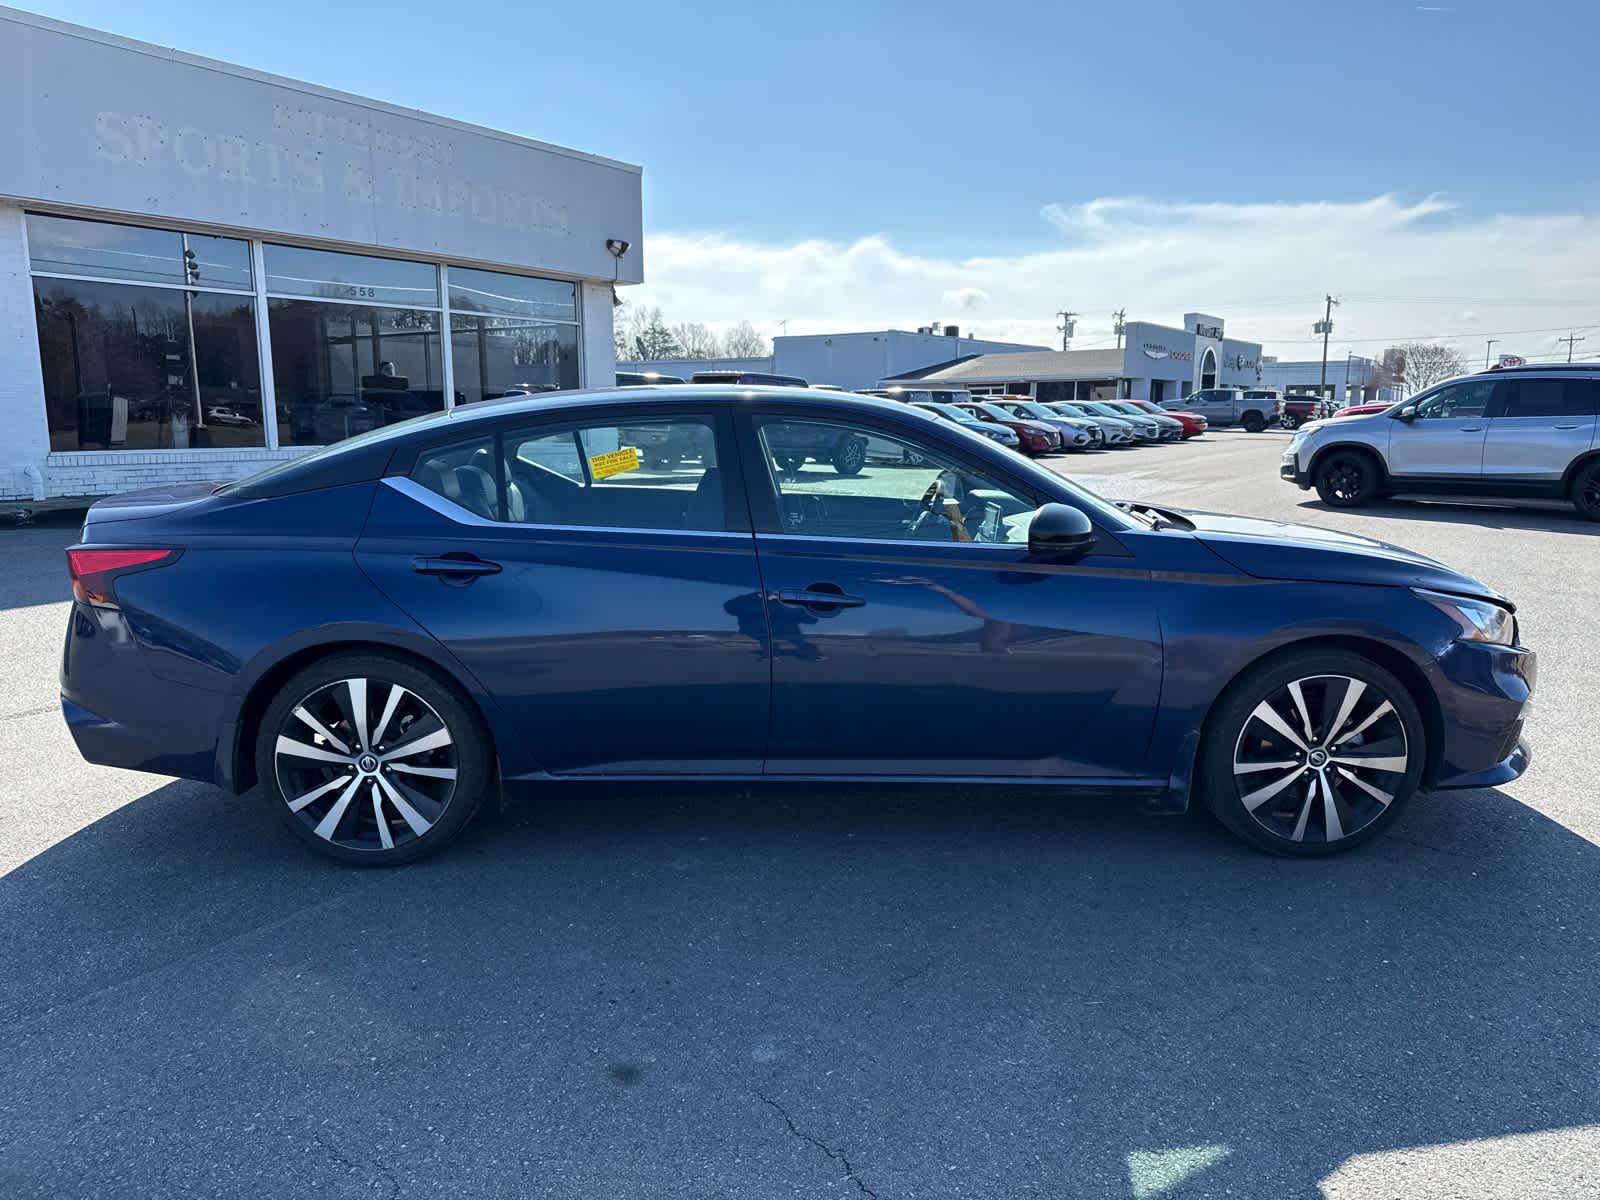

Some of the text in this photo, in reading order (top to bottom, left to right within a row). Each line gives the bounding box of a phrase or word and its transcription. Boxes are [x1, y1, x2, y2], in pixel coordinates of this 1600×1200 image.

[94, 110, 326, 194] SPORTS
[387, 166, 570, 236] IMPORTS
[349, 286, 376, 298] 558
